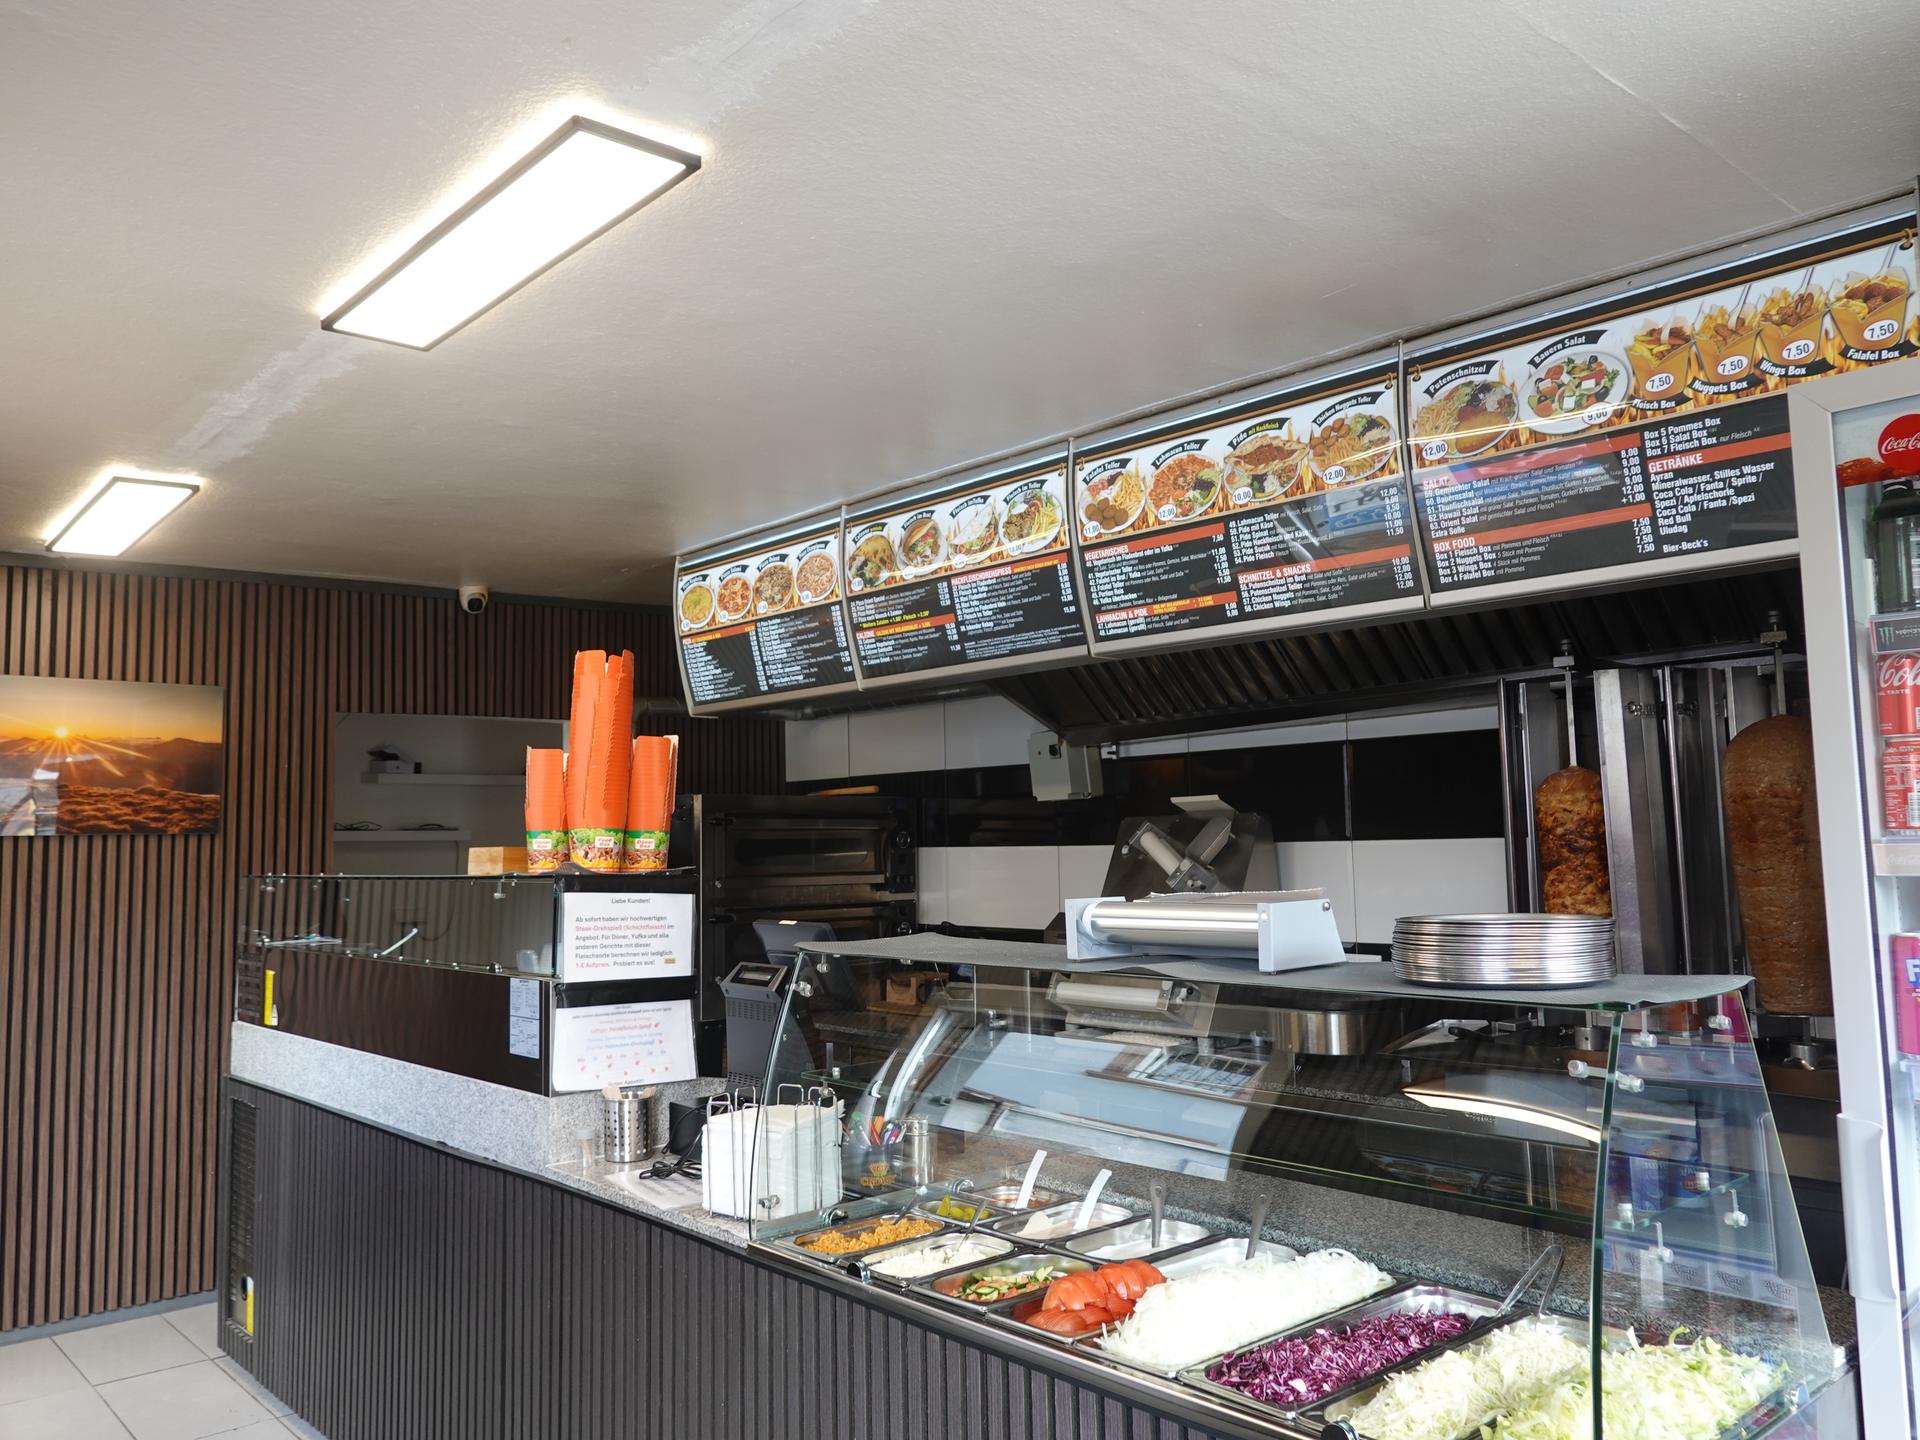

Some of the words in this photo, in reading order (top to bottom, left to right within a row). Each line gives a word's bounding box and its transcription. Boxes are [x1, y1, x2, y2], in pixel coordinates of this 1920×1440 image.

[1867, 324, 1895, 340] 7,50
[1534, 341, 1563, 363] Bauern
[1564, 335, 1587, 349] Salat
[1786, 344, 1810, 358] 7,50
[1847, 349, 1880, 361] Falafel
[1881, 349, 1900, 360] Box
[1721, 359, 1744, 373] 7,50
[1759, 361, 1786, 376] Wings
[1787, 366, 1806, 376] Box
[1429, 365, 1487, 393] Putenschnitzel
[1649, 375, 1672, 389] 7,50
[1692, 379, 1728, 394] Nuggets
[1730, 380, 1748, 391] Box
[1316, 407, 1335, 425] Chicken
[1335, 398, 1357, 413] Nuggets
[1358, 395, 1372, 404] Teller
[1632, 399, 1658, 410] Fleisch
[1660, 399, 1676, 409] Box
[1233, 432, 1248, 446] Pide
[1256, 422, 1279, 432] Hackfleisch
[1643, 429, 1658, 439] Box
[1660, 427, 1666, 436] 5
[1667, 420, 1703, 434] Pommes
[1704, 416, 1720, 426] Box
[1645, 438, 1660, 448] Box
[1662, 436, 1667, 444] 6
[1669, 432, 1690, 443] Salat
[1691, 428, 1707, 438] Box
[1646, 446, 1661, 456] Box
[1663, 445, 1668, 453] 7
[1670, 438, 1700, 452] Fleisch
[1701, 435, 1717, 445] Box
[1730, 429, 1752, 440] Fleisch
[1156, 446, 1184, 466] Lahmacun
[1184, 443, 1200, 451] Teller
[1424, 444, 1447, 457] 12,00
[1620, 447, 1638, 458] 8,00
[1622, 456, 1639, 467] 9,00
[1648, 453, 1703, 473] GETRÄNKE
[1086, 464, 1104, 482] Falafel
[1104, 461, 1121, 471] Teller
[1324, 469, 1344, 481] 12,00
[1623, 465, 1641, 476] 9,00
[1650, 471, 1673, 482] Ayran
[1651, 473, 1711, 491] Mineralwasser,
[1714, 466, 1740, 479] Stilles
[1742, 460, 1774, 474] Wasser
[1422, 476, 1448, 489] SALAT
[1624, 474, 1642, 485] 9,00
[1653, 489, 1672, 500] Coca
[1675, 485, 1693, 496] Cola
[1700, 479, 1723, 491] Fanta
[1731, 473, 1757, 487] Sprite
[1379, 487, 1397, 497] 12,00
[1424, 489, 1434, 497] 59.
[1434, 482, 1471, 495] Gemischter
[1472, 478, 1490, 488] Salat
[1622, 483, 1643, 494] 12,00
[1234, 492, 1251, 502] 10,00
[1425, 498, 1436, 506] 60.
[1435, 490, 1474, 504] Bauernsalat
[1437, 497, 1483, 512] Thunfischsalat
[1654, 497, 1676, 509] Spezi
[1683, 486, 1735, 504] Apfelschorle
[1159, 508, 1175, 519] 12,00
[1439, 509, 1461, 519] Hawaii
[1462, 506, 1479, 515] Salat
[1656, 506, 1676, 517] Coca
[1677, 502, 1696, 513] Cola
[1703, 497, 1726, 509] Fanta
[1440, 518, 1460, 527] Orient
[1460, 515, 1478, 524] Salat
[1632, 516, 1649, 528] 7,50
[1658, 516, 1673, 526] Red
[1675, 513, 1691, 523] Bull
[1431, 529, 1447, 538] Extra
[1448, 525, 1465, 534] Soße
[1634, 525, 1651, 536] 7,50
[1659, 522, 1687, 533] Uludag
[1433, 541, 1450, 552] BOX
[1451, 536, 1475, 549] FOOD
[1635, 534, 1653, 545] 7,50
[1084, 545, 1128, 560] VEGETARISCHES
[1435, 552, 1447, 560] Box
[1454, 547, 1477, 557] Fleisch
[1478, 544, 1491, 552] Box
[1637, 542, 1654, 553] 7,50
[1436, 560, 1449, 568] Box
[1456, 554, 1482, 565] Nuggets
[1483, 551, 1496, 560] Box
[1238, 569, 1274, 584] SCHNITZEL
[1275, 568, 1281, 577] &
[1282, 563, 1311, 576] SNACKS
[1438, 567, 1450, 575] Box
[1457, 563, 1478, 573] Wings
[1479, 560, 1491, 568] Box
[1440, 575, 1452, 583] Box
[1459, 570, 1481, 580] Falafel
[1482, 568, 1494, 576] Box
[1095, 611, 1127, 623] LAHMACUN
[1133, 607, 1148, 617] PIDE
